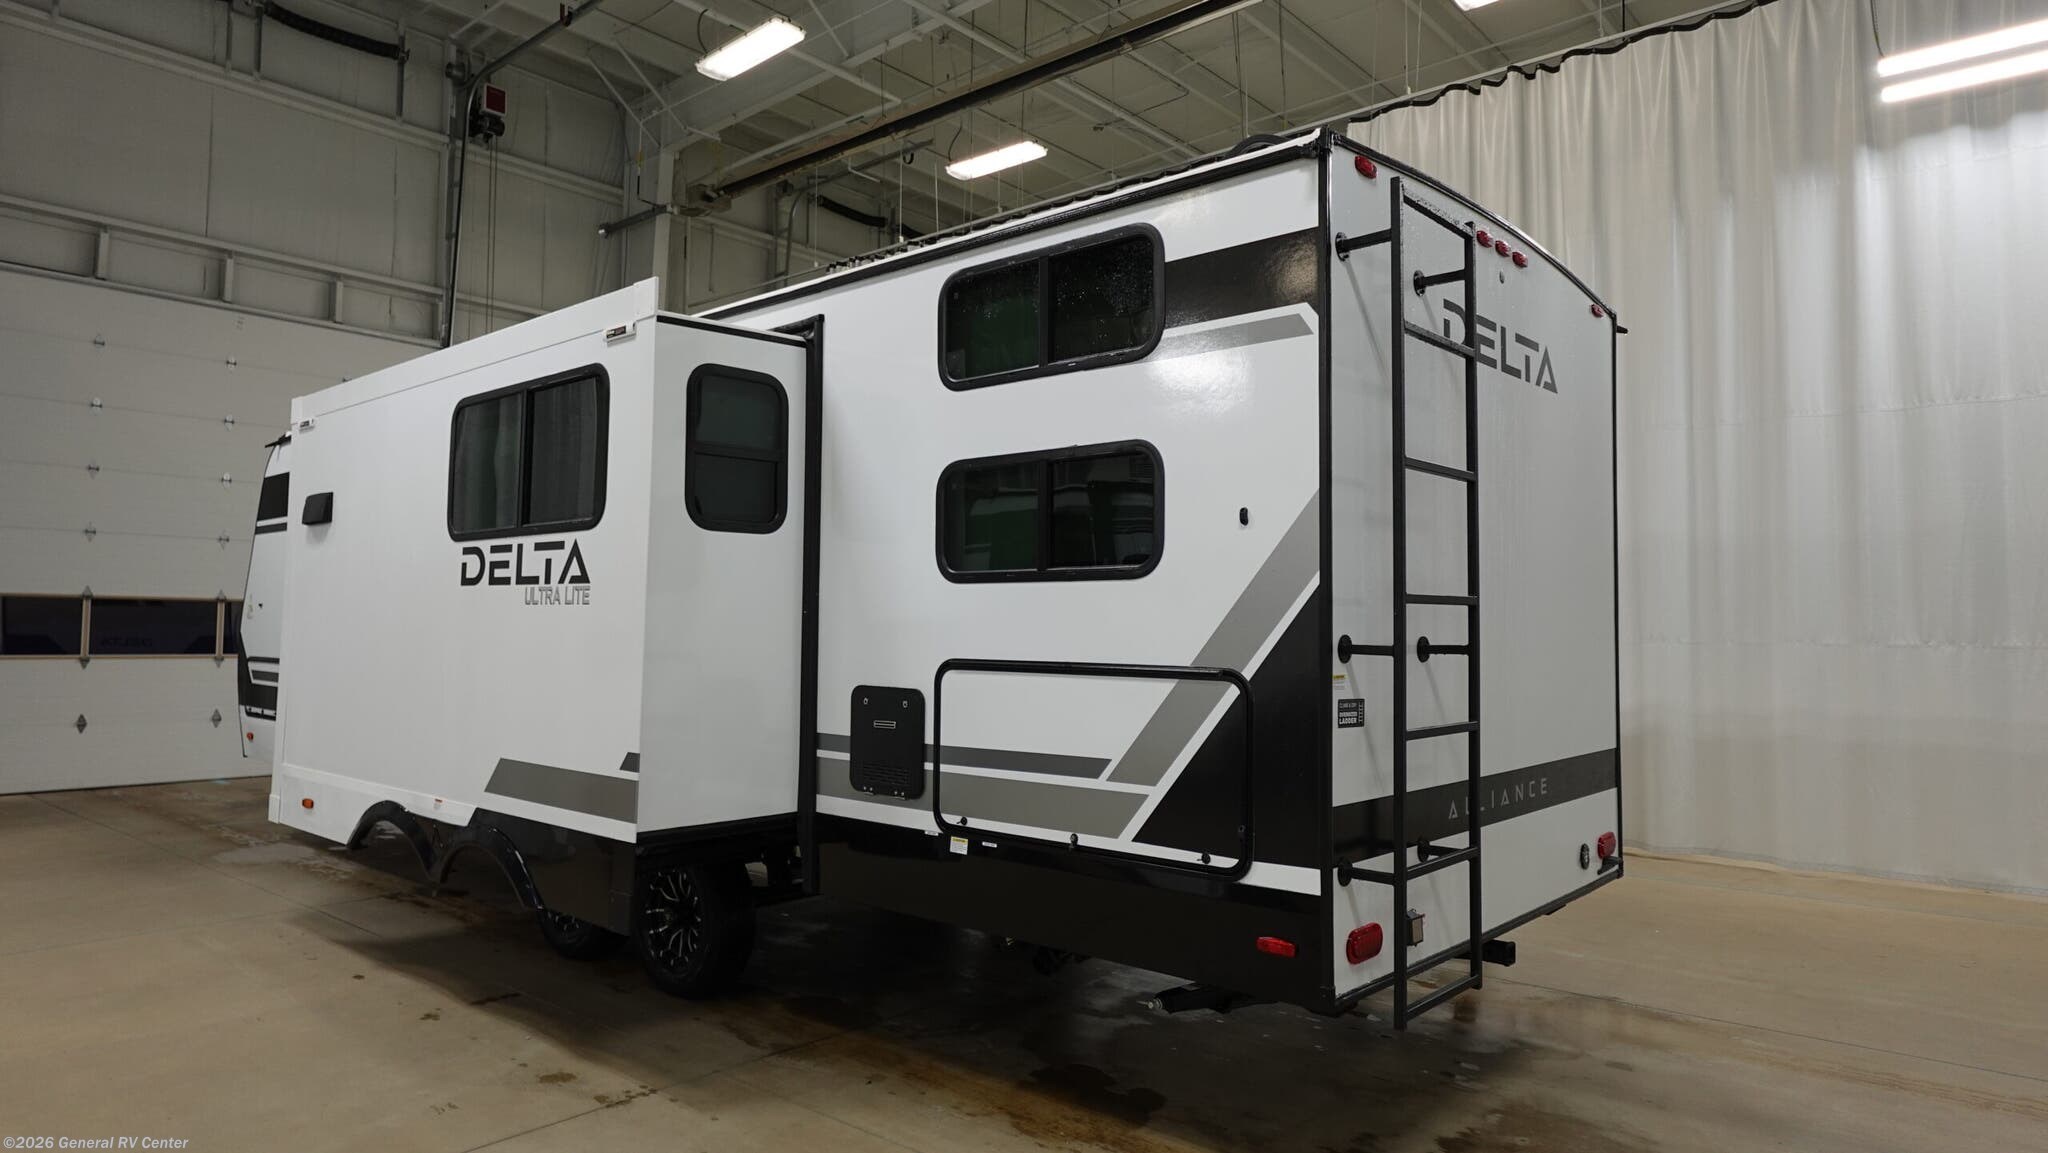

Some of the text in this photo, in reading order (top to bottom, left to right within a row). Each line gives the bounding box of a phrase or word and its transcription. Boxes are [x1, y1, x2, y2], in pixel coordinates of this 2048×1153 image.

[1443, 298, 1558, 394] DELTA
[460, 538, 591, 586] DELTA
[525, 585, 591, 605] ULTRA LITE
[1448, 778, 1548, 820] ALIANCE
